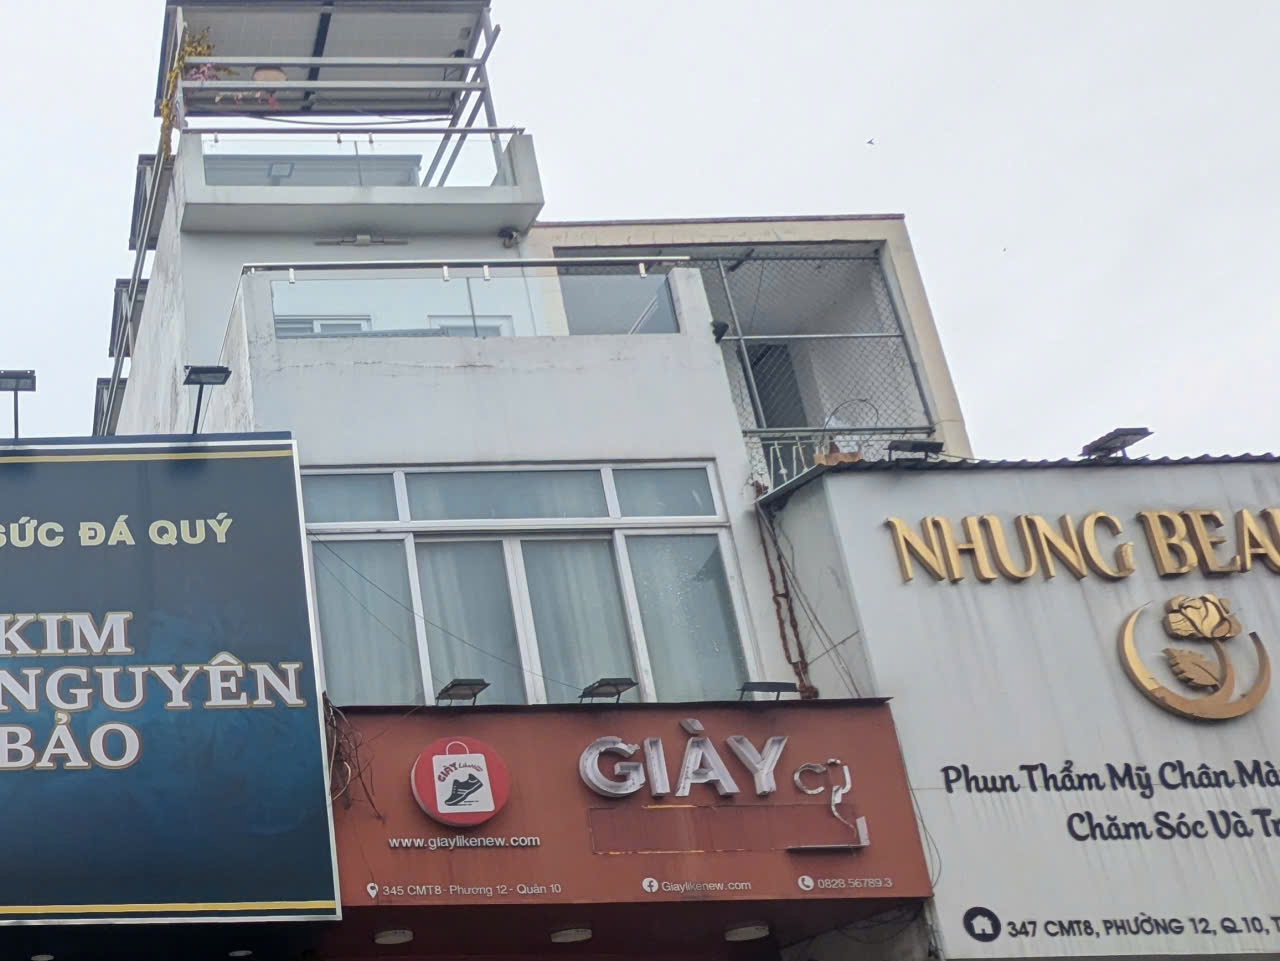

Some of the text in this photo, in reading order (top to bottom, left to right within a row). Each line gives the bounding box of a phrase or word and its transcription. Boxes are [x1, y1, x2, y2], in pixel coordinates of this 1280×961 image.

[79, 514, 135, 546] ĐÁ
[149, 512, 233, 545] QUÝ
[884, 511, 1136, 584] NHUNG
[437, 761, 459, 783] GIÀY
[579, 717, 788, 798] GIÀY
[940, 764, 1021, 794] Phun
[1019, 759, 1106, 793] Thẩm
[1105, 762, 1155, 800] Mỹ
[1158, 759, 1236, 791] Chân
[1066, 810, 1153, 842] Chăm
[1153, 811, 1209, 841] Sóc
[1206, 809, 1254, 840] Và
[388, 835, 541, 851] www.giaylikenew.com
[382, 885, 404, 896] 345
[496, 884, 508, 895] 12
[549, 883, 562, 894] 10
[1007, 920, 1037, 937] 347
[1044, 919, 1100, 938] CMT8,
[1102, 911, 1185, 937] PHƯỜNG
[1187, 917, 1218, 936] 12,
